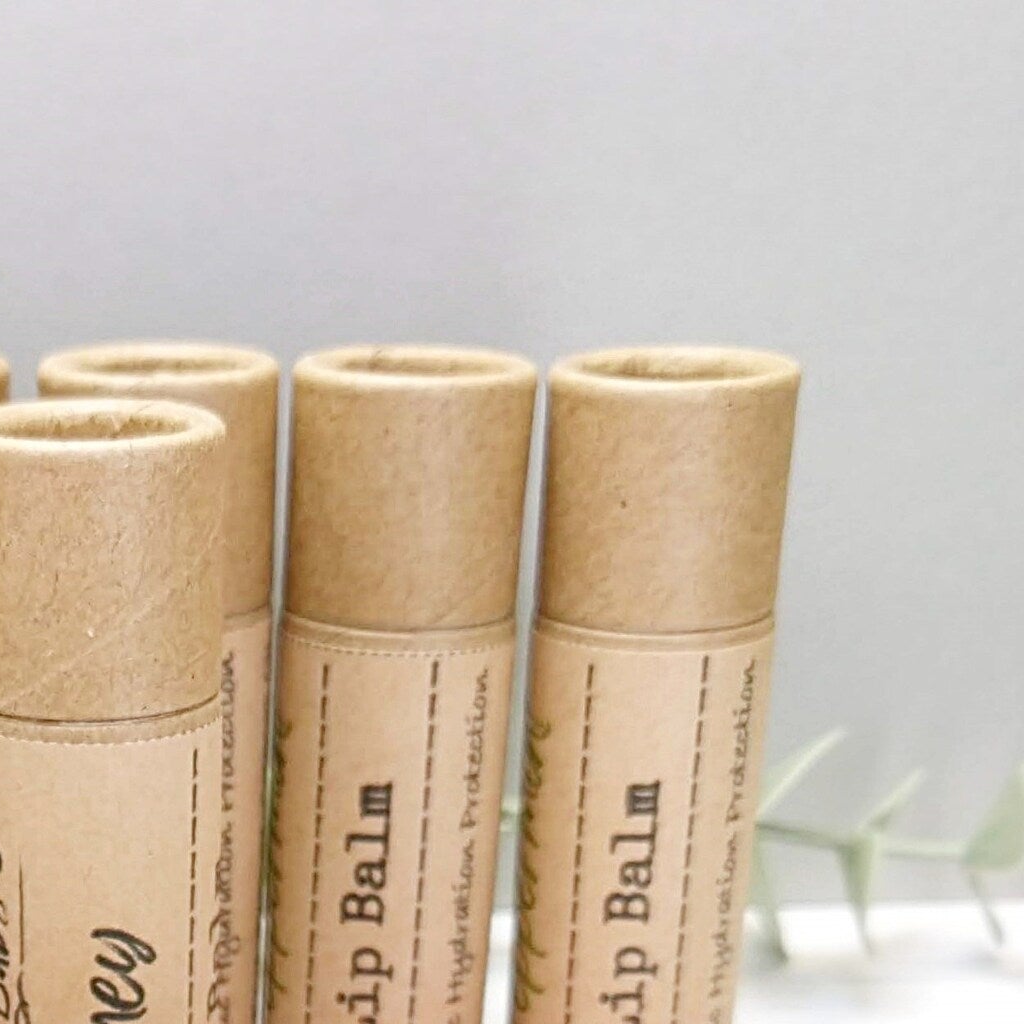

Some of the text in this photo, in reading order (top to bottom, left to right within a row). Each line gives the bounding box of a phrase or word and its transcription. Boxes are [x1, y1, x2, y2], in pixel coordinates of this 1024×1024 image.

[459, 667, 489, 830] Protection
[340, 780, 393, 928] Balm
[444, 838, 475, 1004] Hydration
[602, 779, 662, 927] Balm
